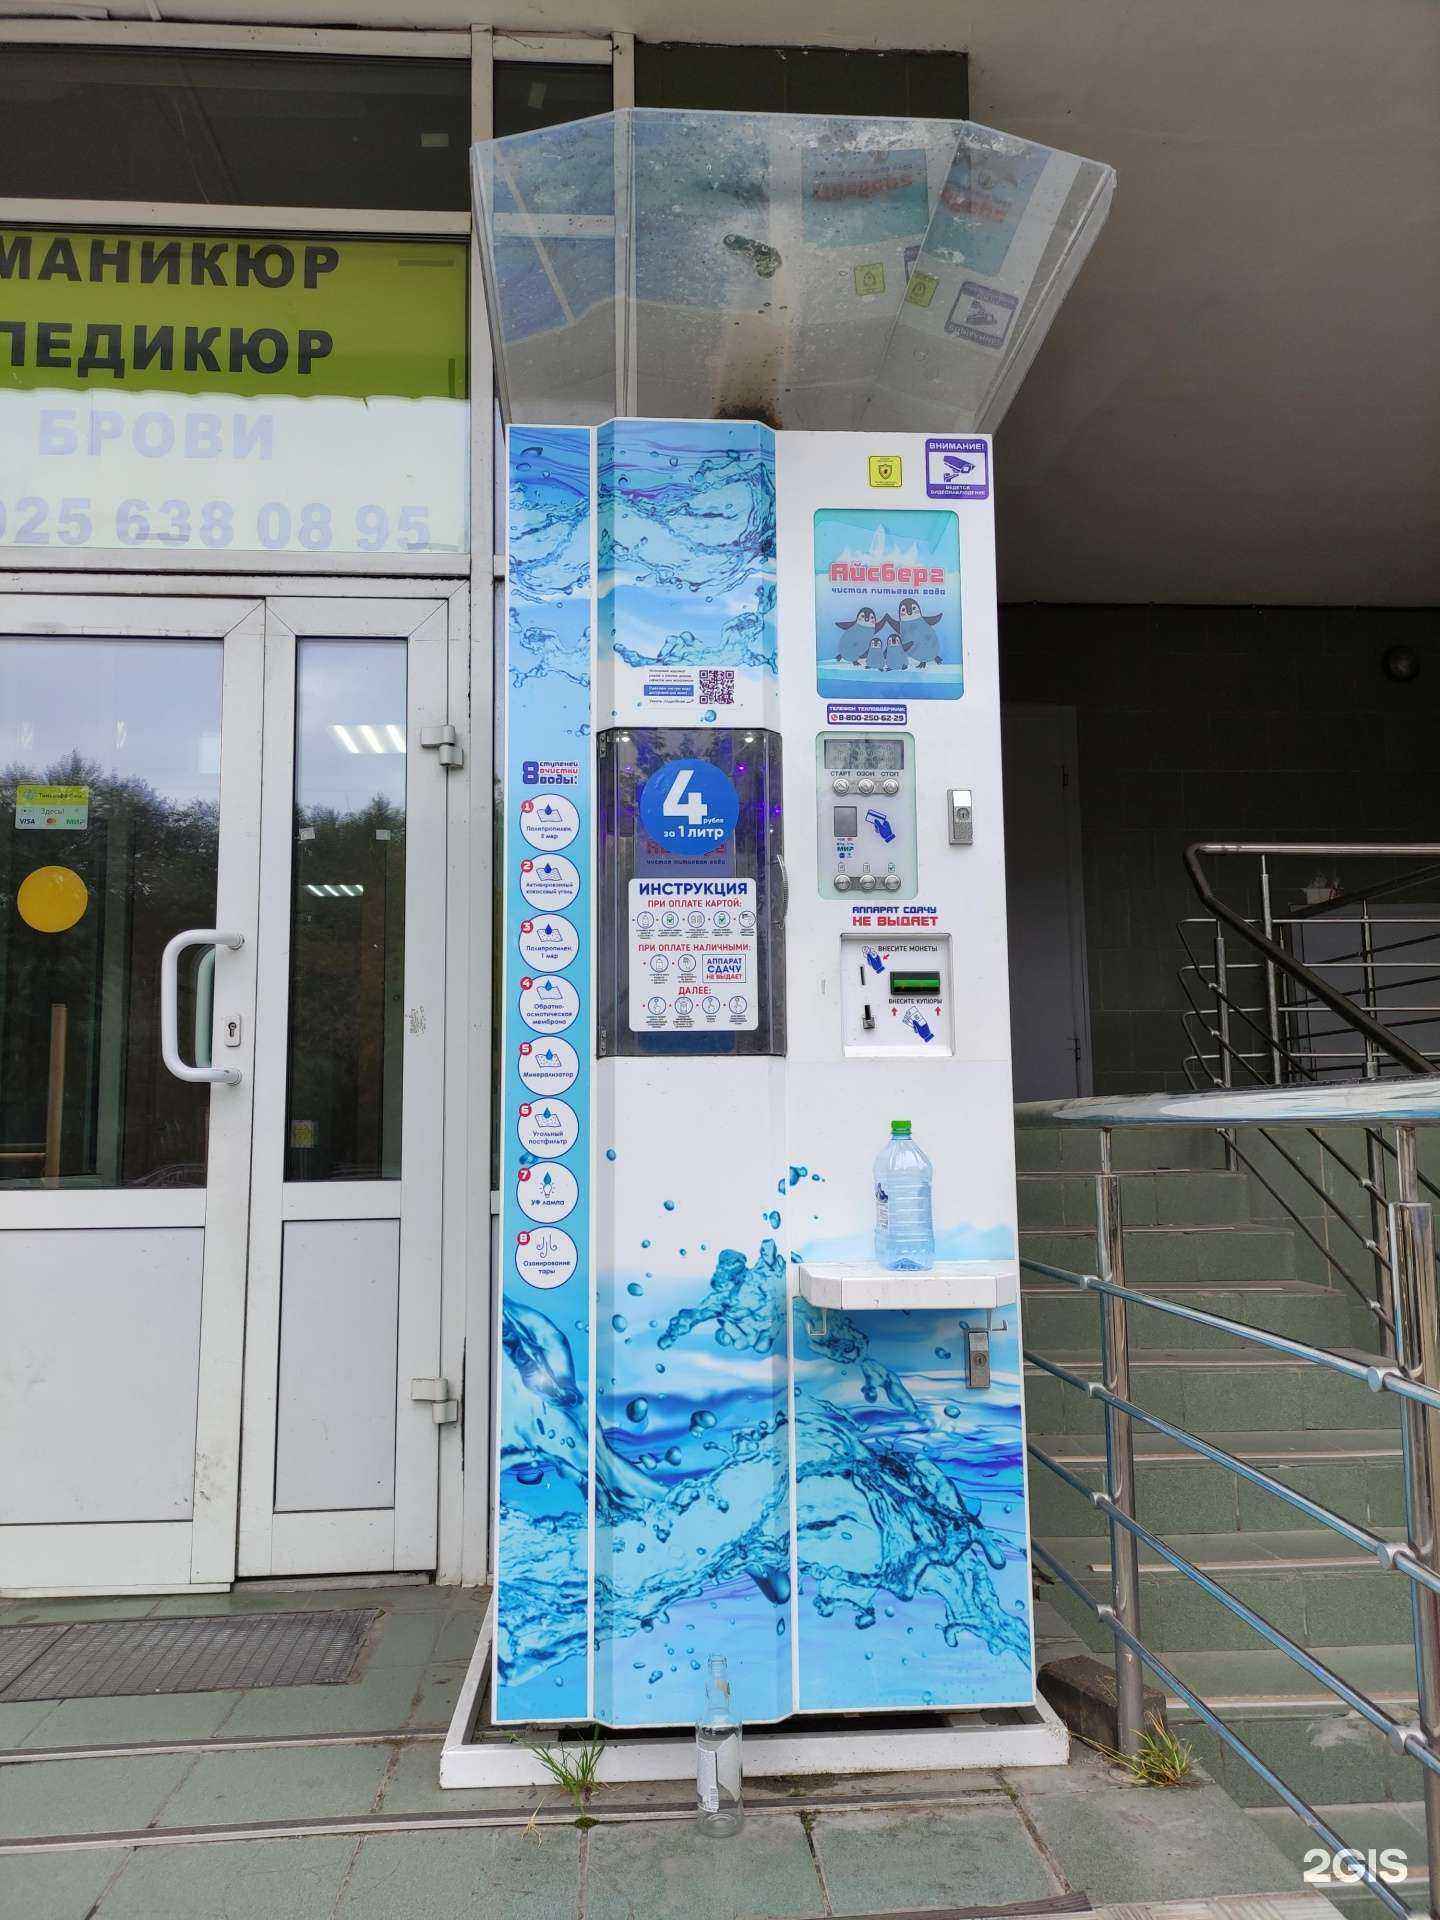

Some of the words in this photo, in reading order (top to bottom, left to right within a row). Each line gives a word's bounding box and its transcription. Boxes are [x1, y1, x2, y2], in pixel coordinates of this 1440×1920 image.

[0, 236, 340, 289] МАНИКЮР
[0, 321, 334, 379] ПЕДИКЮР
[38, 409, 275, 460] БРОВИ
[929, 442, 984, 450] ВНИМАНИЕ!
[0, 496, 93, 546] 25
[115, 499, 235, 549] 638
[256, 502, 333, 551] 08
[354, 504, 432, 552] 95
[829, 561, 945, 587] Айсберг
[522, 761, 539, 785] 8
[663, 770, 707, 824] 4
[703, 817, 724, 826] рубля
[678, 825, 685, 838] 1
[687, 828, 724, 840] литр
[639, 883, 748, 896] ИНСТРУКЦИЯ
[705, 899, 742, 907] КАРТОЙ:
[852, 906, 899, 914] АППАРАТ
[903, 906, 937, 914] СДАЧУ
[852, 917, 871, 926] НЕ
[877, 917, 938, 926] ВЫДАЕТ
[679, 987, 711, 995] ДАЛЕЕ:
